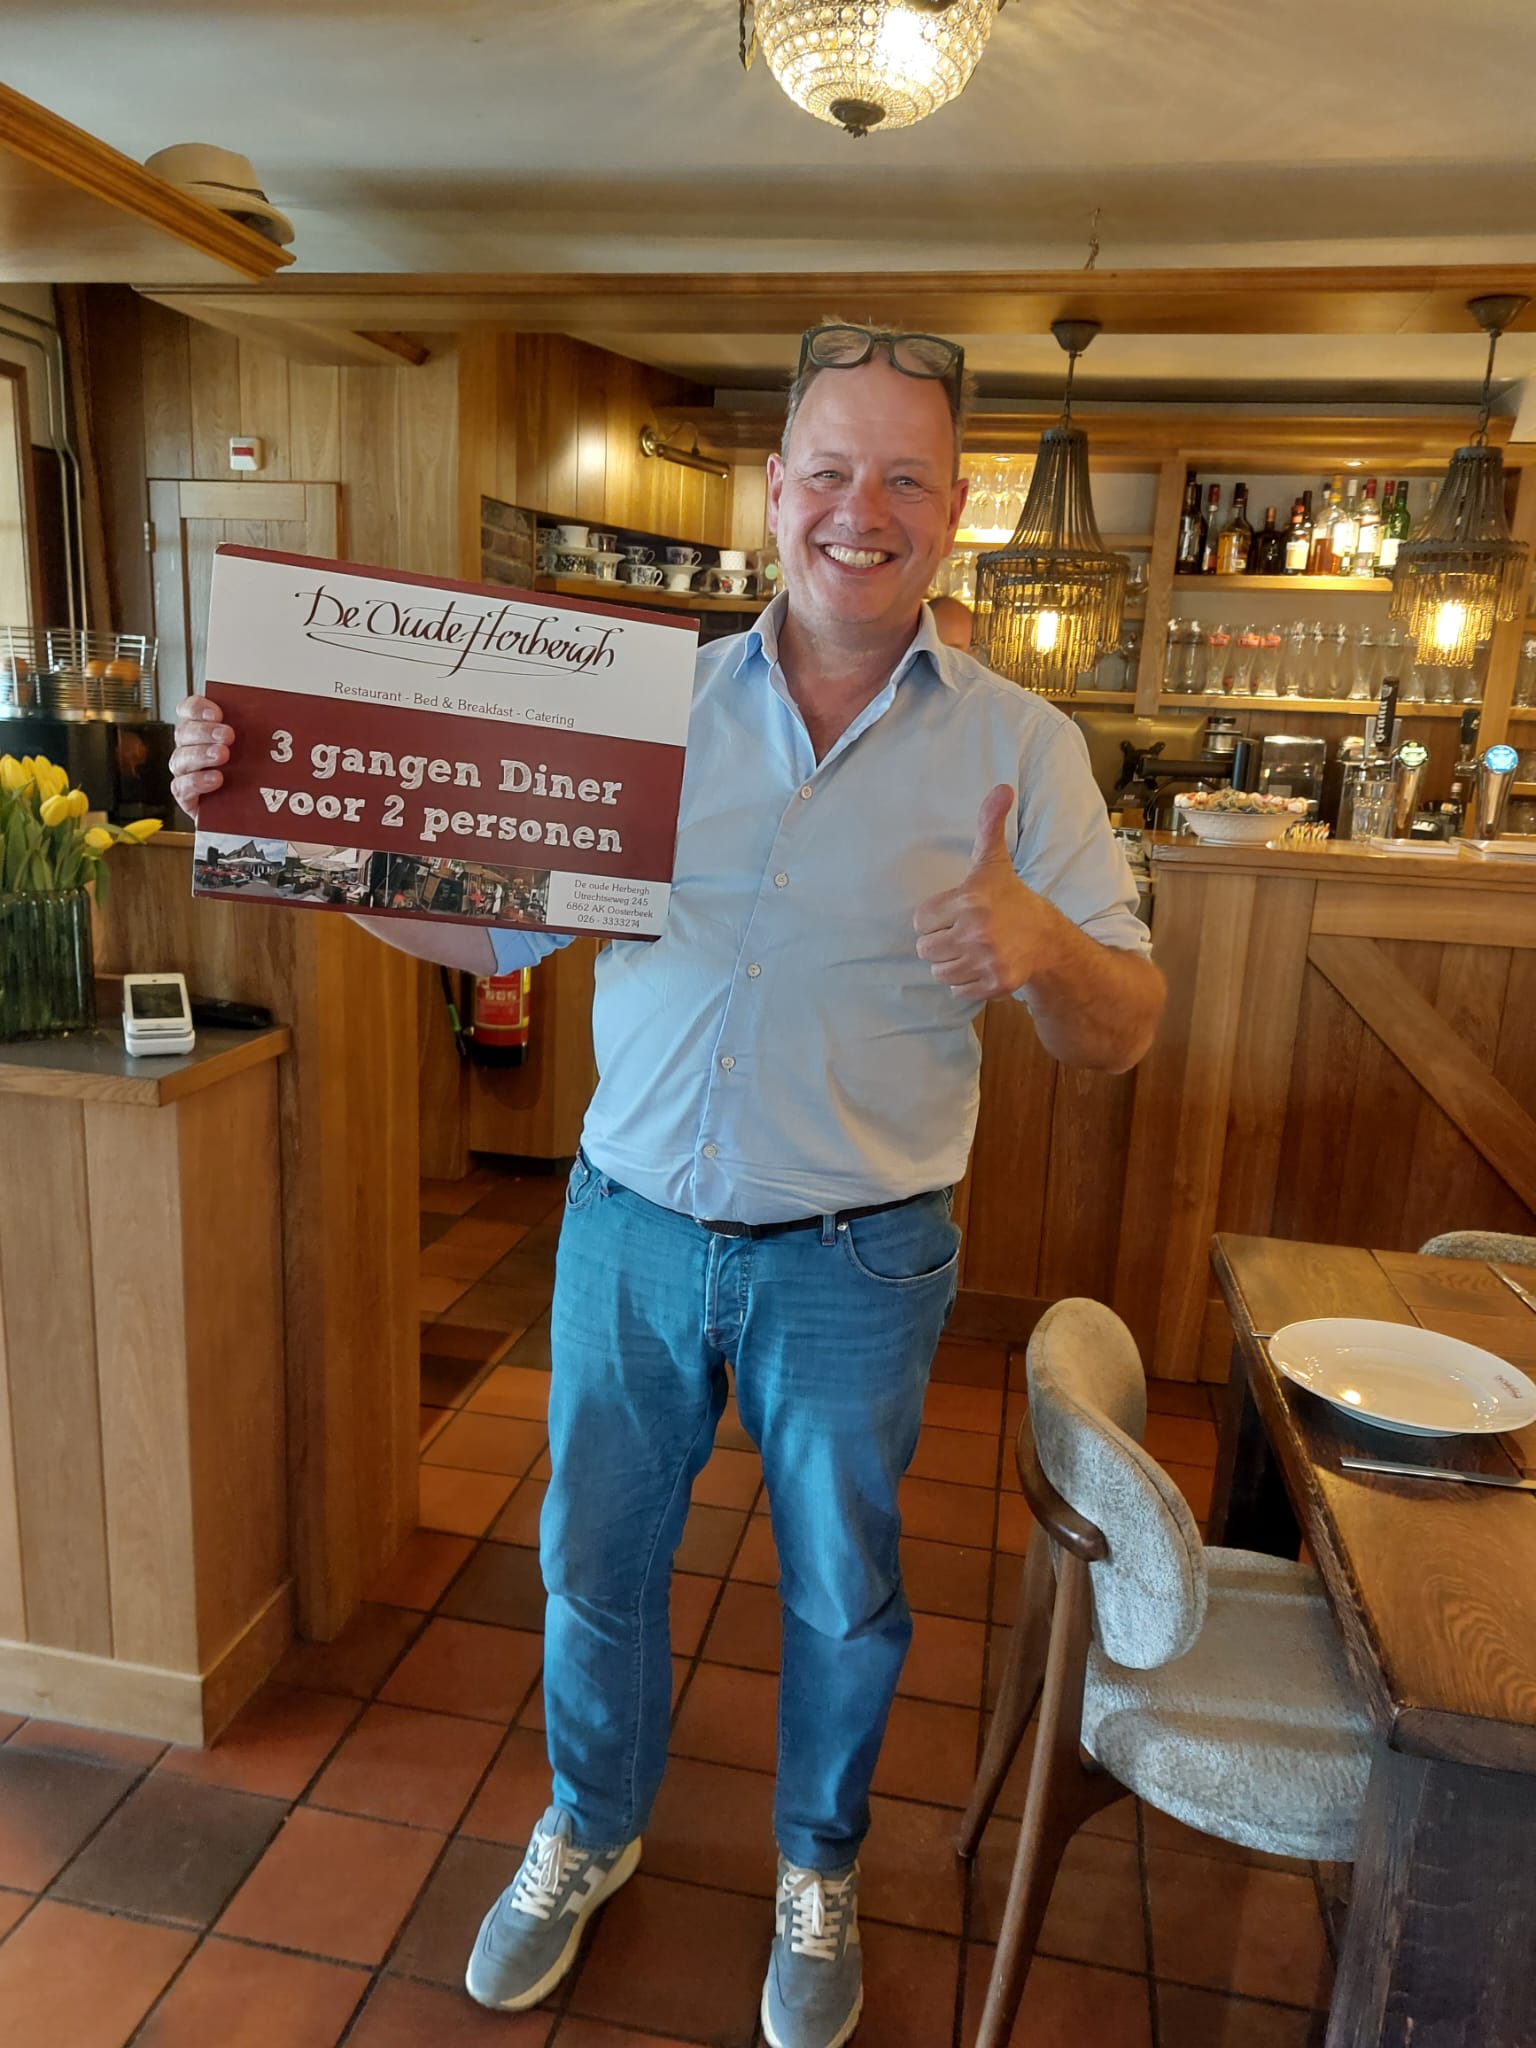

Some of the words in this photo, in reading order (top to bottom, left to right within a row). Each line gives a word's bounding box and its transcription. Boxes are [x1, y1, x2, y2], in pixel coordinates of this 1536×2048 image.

[295, 585, 362, 628] De
[364, 599, 465, 644] Oude
[334, 681, 402, 702] Restaurant
[414, 692, 438, 708] Bed
[441, 698, 453, 710] &
[457, 699, 513, 718] Breakfast
[525, 709, 575, 728] Catering
[270, 730, 293, 762] 3
[310, 743, 481, 790] gangen
[498, 759, 623, 805] Diner
[259, 787, 365, 822] voor
[381, 795, 404, 827] 2
[419, 806, 622, 853] personen
[574, 879, 587, 888] De
[589, 882, 609, 891] oude
[612, 883, 650, 896] Herbergh
[574, 891, 629, 906] Utrechtseweg
[631, 897, 649, 906] 245
[566, 902, 589, 912] 6862
[591, 904, 605, 913] AK
[607, 906, 653, 919] Oosterbeek
[577, 914, 595, 923] 026
[602, 918, 640, 929] 3333274
